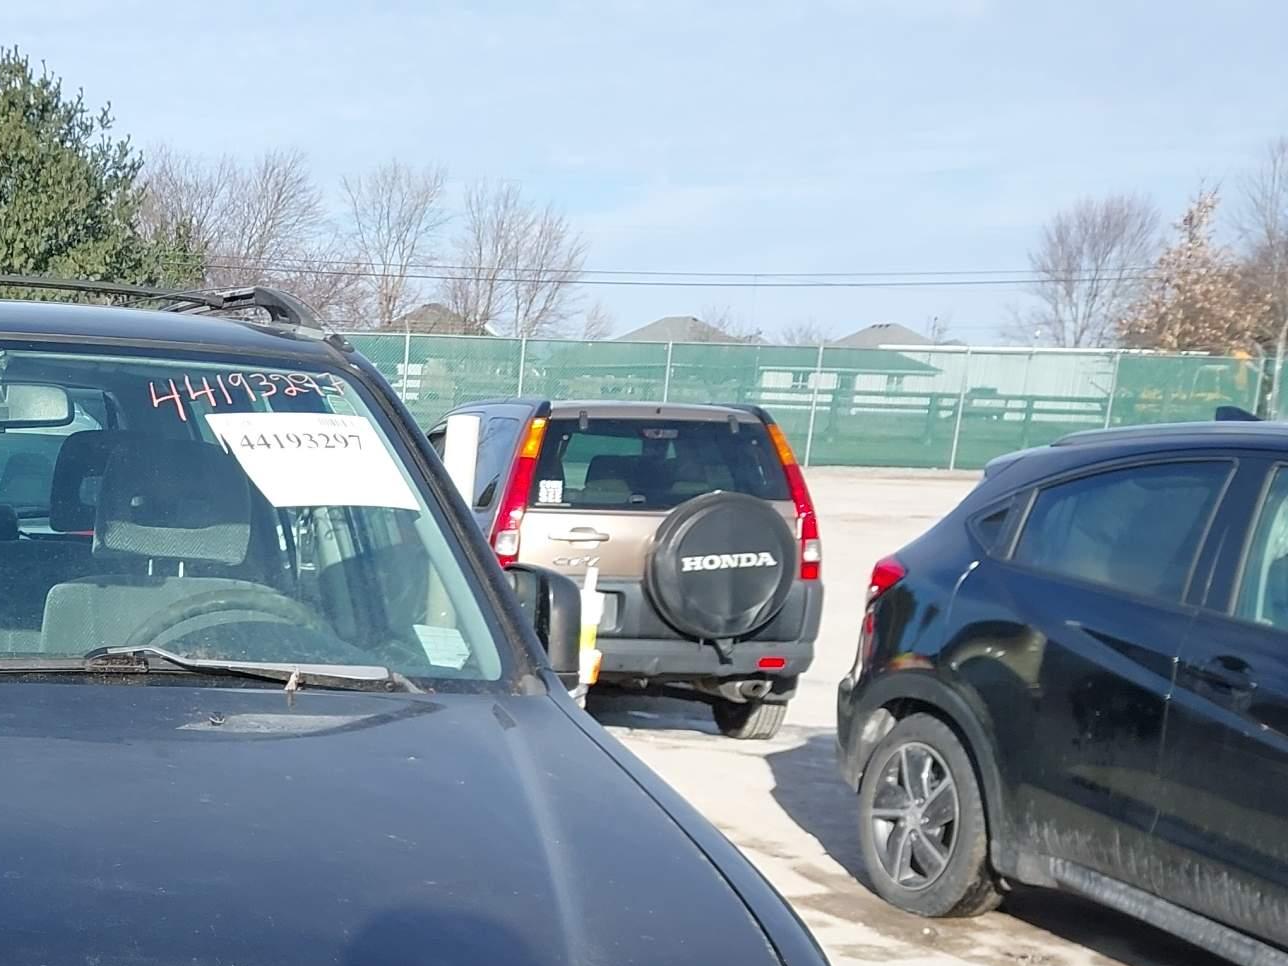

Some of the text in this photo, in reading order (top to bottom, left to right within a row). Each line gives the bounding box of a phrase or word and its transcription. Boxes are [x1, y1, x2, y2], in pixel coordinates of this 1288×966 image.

[148, 372, 346, 422] 44193297
[239, 432, 363, 451] 44193297
[681, 552, 778, 573] HONDA
